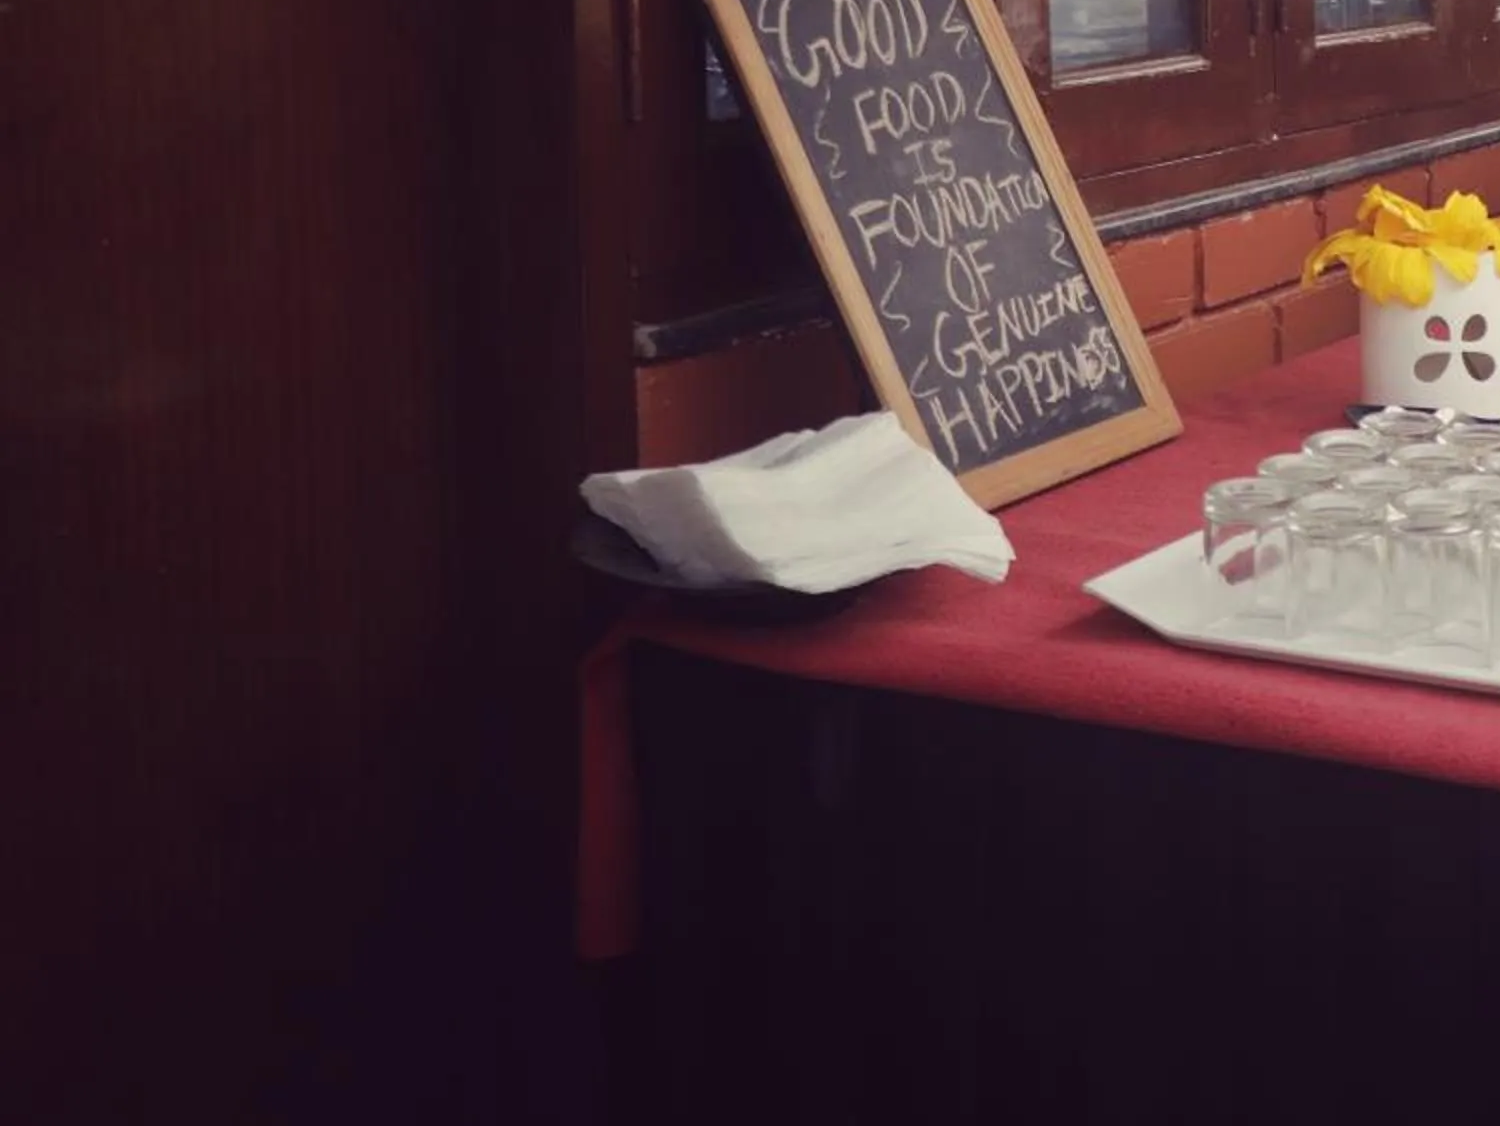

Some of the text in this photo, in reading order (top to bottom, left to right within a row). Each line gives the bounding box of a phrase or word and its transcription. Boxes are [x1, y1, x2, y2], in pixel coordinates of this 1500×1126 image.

[854, 72, 966, 154] FOOD
[903, 137, 955, 185] IS
[945, 235, 995, 314] OF
[933, 274, 1096, 379] GENUINE
[928, 326, 1121, 467] HAPPINSS
